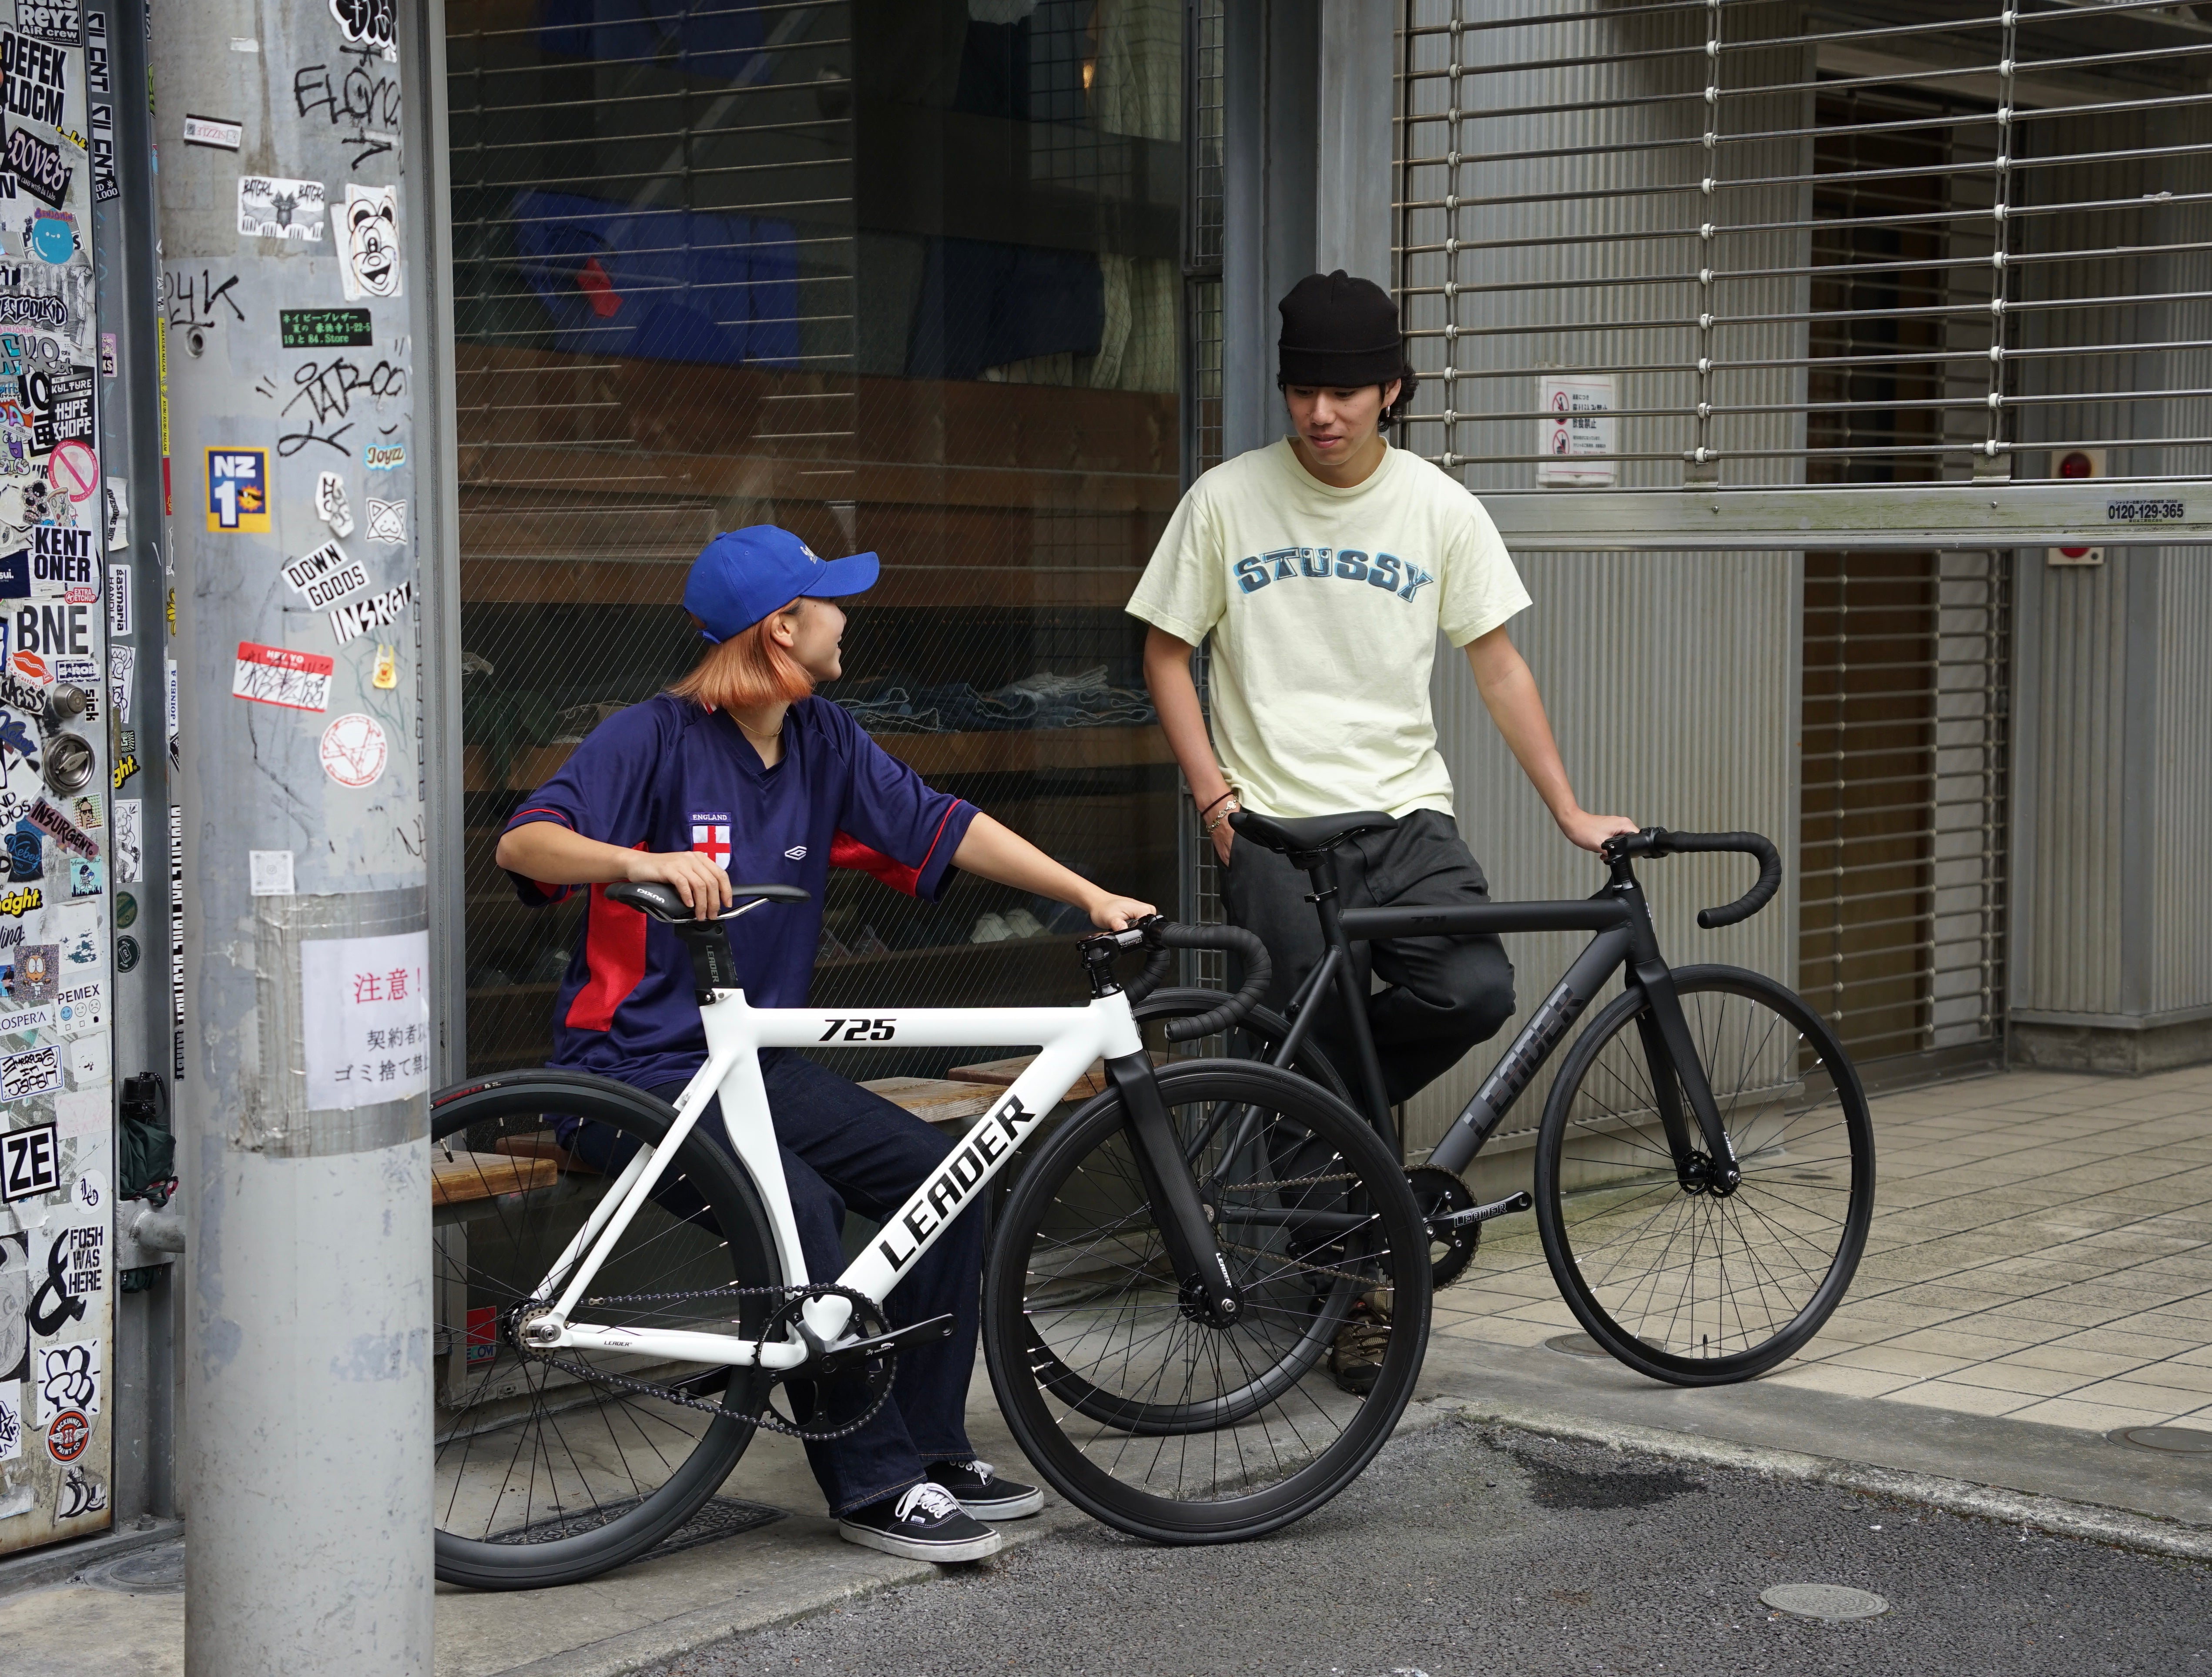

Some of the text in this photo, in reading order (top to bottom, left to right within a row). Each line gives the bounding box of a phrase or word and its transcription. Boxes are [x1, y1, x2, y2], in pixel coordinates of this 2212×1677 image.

[47, 29, 77, 38] crew
[51, 379, 92, 394] KULTURE
[55, 399, 88, 421] HYPE
[214, 455, 256, 479] NZ
[214, 481, 236, 525] 1
[2108, 503, 2184, 519] 0120-129-365
[35, 527, 91, 557] KENT
[34, 554, 90, 582] ONER
[288, 545, 342, 588] DOWN
[1233, 546, 1434, 603] STUSSY
[308, 565, 365, 606] GOODS
[17, 605, 89, 655] BNE
[290, 654, 304, 664] YO
[706, 945, 720, 983] LEADER
[58, 984, 100, 1004] PEMEX
[353, 967, 421, 1004] 注意！
[818, 1018, 897, 1041] 725
[1463, 982, 1586, 1141] LEADER
[1723, 1131, 1736, 1162] LEADER
[7, 1132, 53, 1192] ZE
[878, 1094, 1036, 1273] LEADER
[1454, 1202, 1508, 1228] LEADER
[73, 1249, 100, 1270] WAS
[1215, 1252, 1230, 1287] LEADER
[69, 1269, 102, 1294] HERE
[467, 1344, 493, 1360] ECOM
[57, 1445, 73, 1455] PAINT
